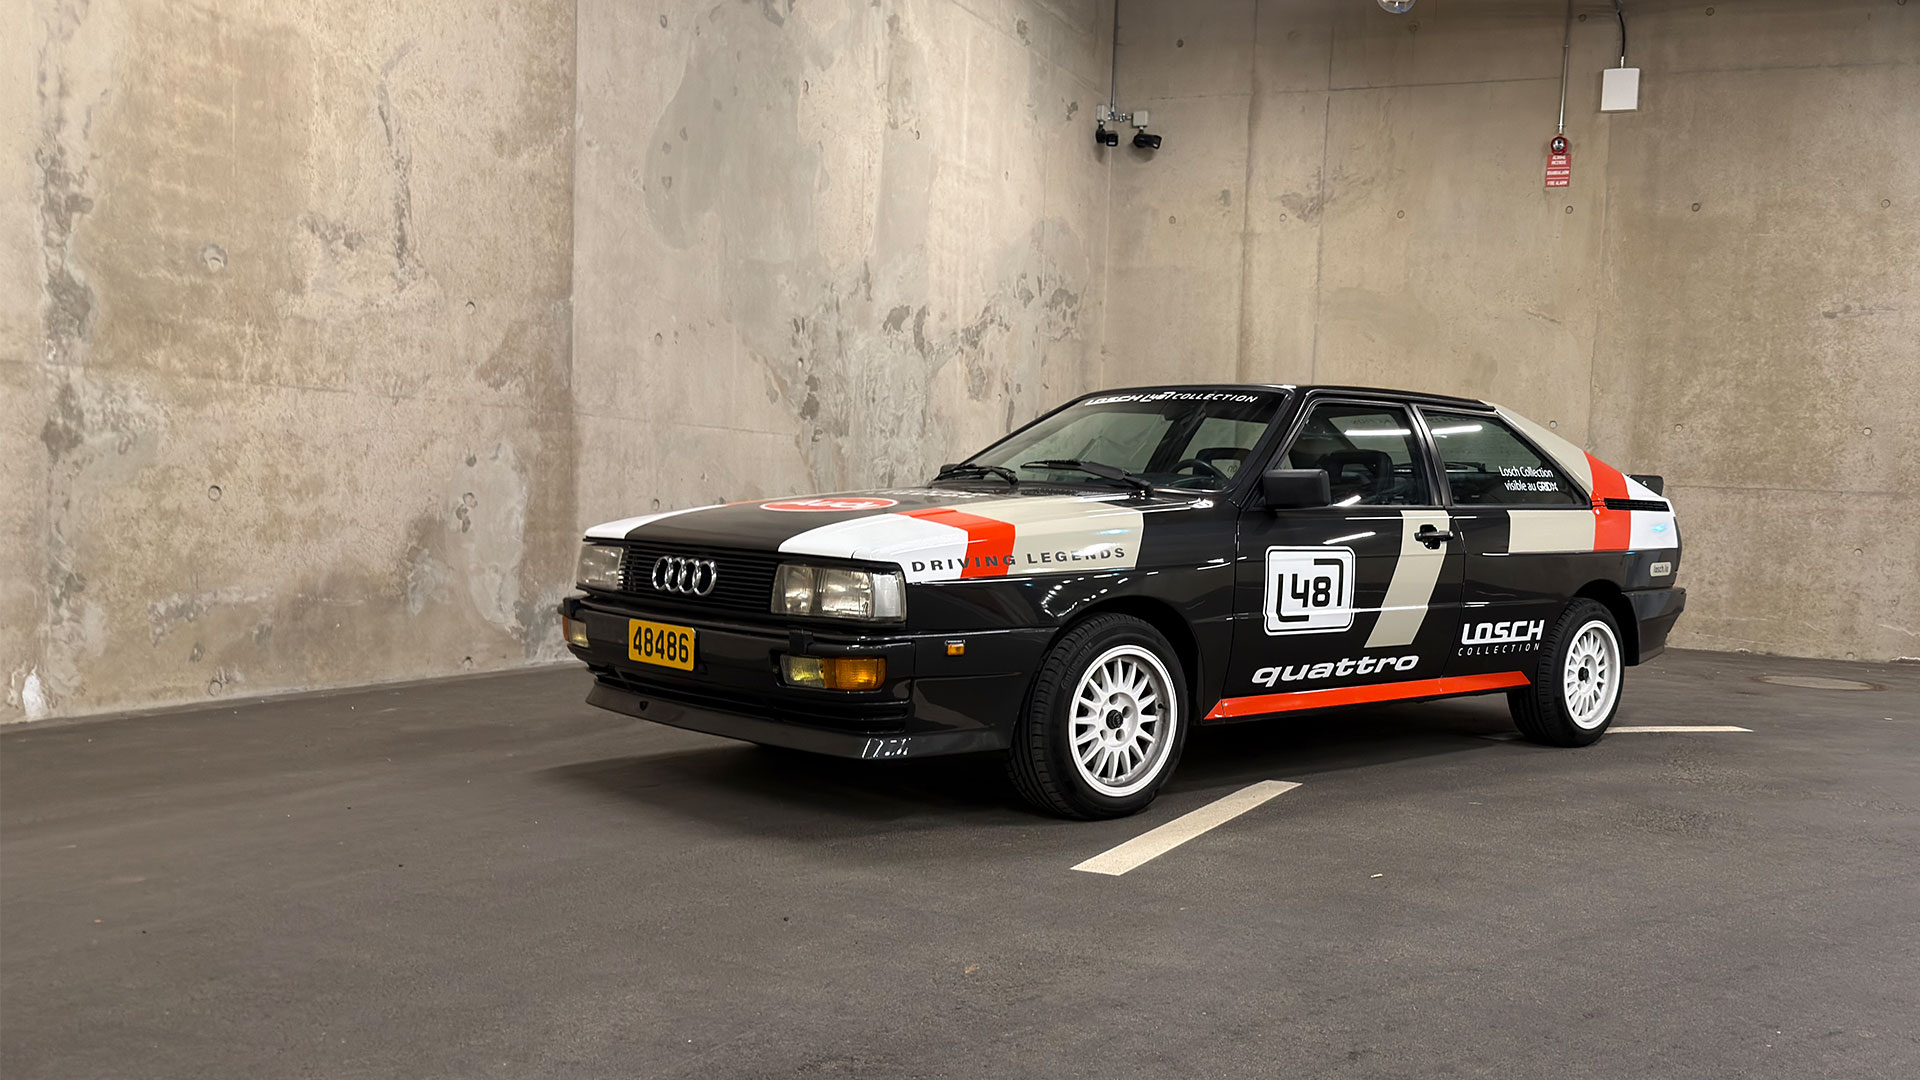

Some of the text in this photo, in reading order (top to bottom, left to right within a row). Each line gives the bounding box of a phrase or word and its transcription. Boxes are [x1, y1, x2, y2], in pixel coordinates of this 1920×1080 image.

[1172, 393, 1259, 403] COLLECTION
[1499, 466, 1554, 478] Losch Collection
[1504, 480, 1528, 491] visible
[911, 547, 1126, 573] DRIVING LEGENDS
[1461, 619, 1545, 645] LOSCH
[633, 626, 689, 664] 48486
[1458, 643, 1540, 656] COLLECTION
[1251, 655, 1420, 688] quattro
